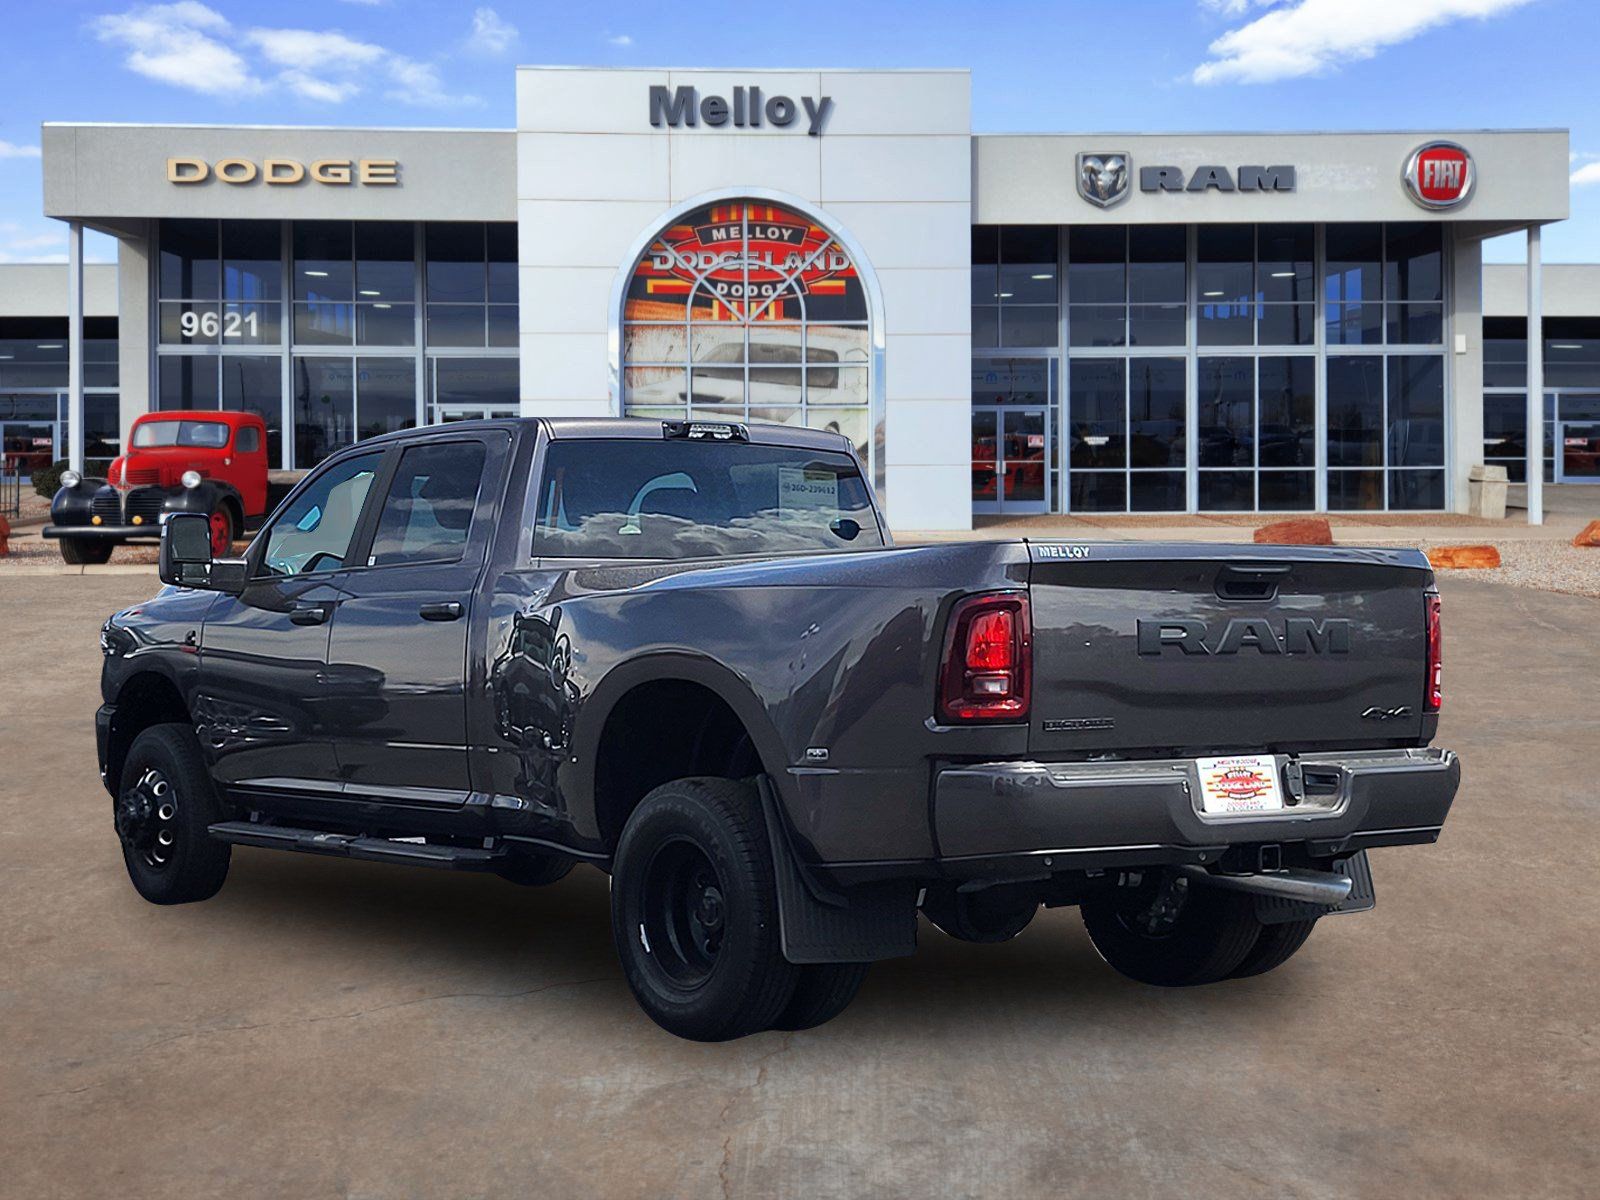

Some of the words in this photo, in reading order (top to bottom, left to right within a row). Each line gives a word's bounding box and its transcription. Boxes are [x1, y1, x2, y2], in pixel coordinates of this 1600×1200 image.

[649, 85, 832, 136] Melloy
[167, 158, 398, 185] DODGE
[1139, 165, 1297, 192] RAM
[1423, 159, 1464, 189] FIAT
[180, 311, 259, 338] 9621
[1038, 545, 1090, 558] MELLOY
[1136, 617, 1351, 656] RAM
